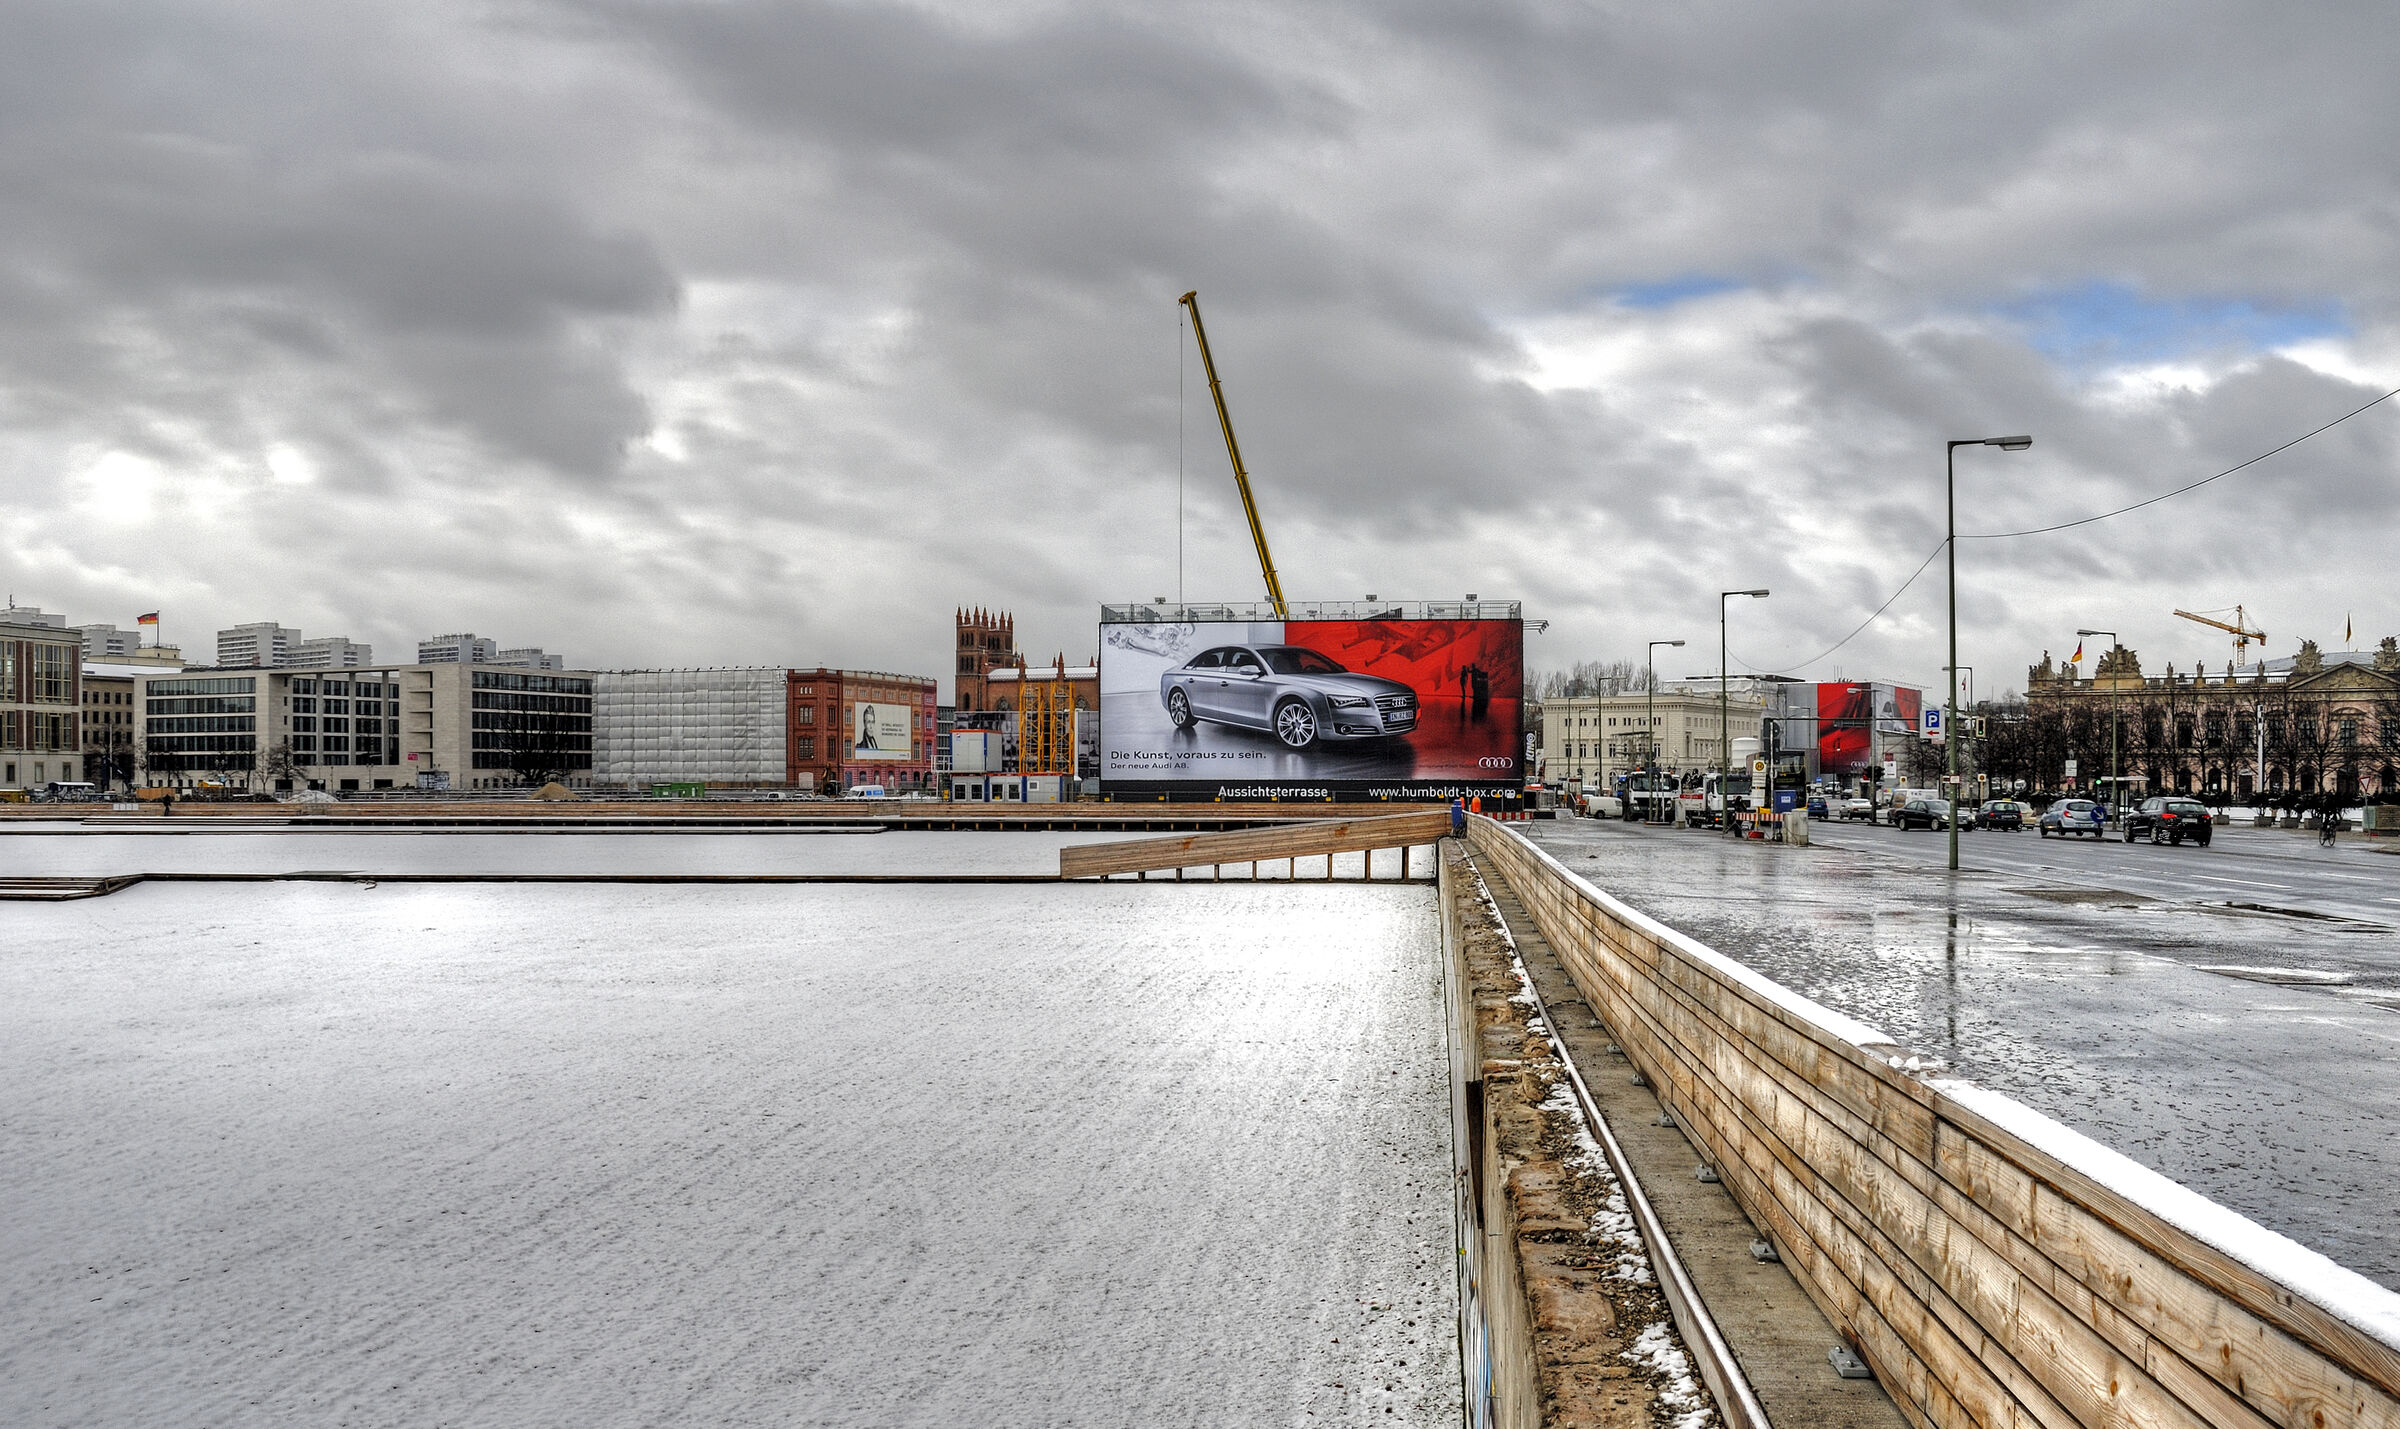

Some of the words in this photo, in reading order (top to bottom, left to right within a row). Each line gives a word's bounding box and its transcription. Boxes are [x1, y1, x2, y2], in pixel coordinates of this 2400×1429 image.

[1928, 714, 1938, 727] P
[1526, 732, 1536, 762] KINO
[1110, 750, 1130, 760] Die
[1133, 750, 1173, 760] Kunst,
[1176, 750, 1217, 760] voraus
[1220, 750, 1234, 760] zu
[1238, 750, 1267, 760] sein.
[1110, 761, 1126, 769] Der
[1218, 785, 1329, 798] Aussichtsterrasse
[1368, 786, 1516, 799] www.humboldt-box.com
